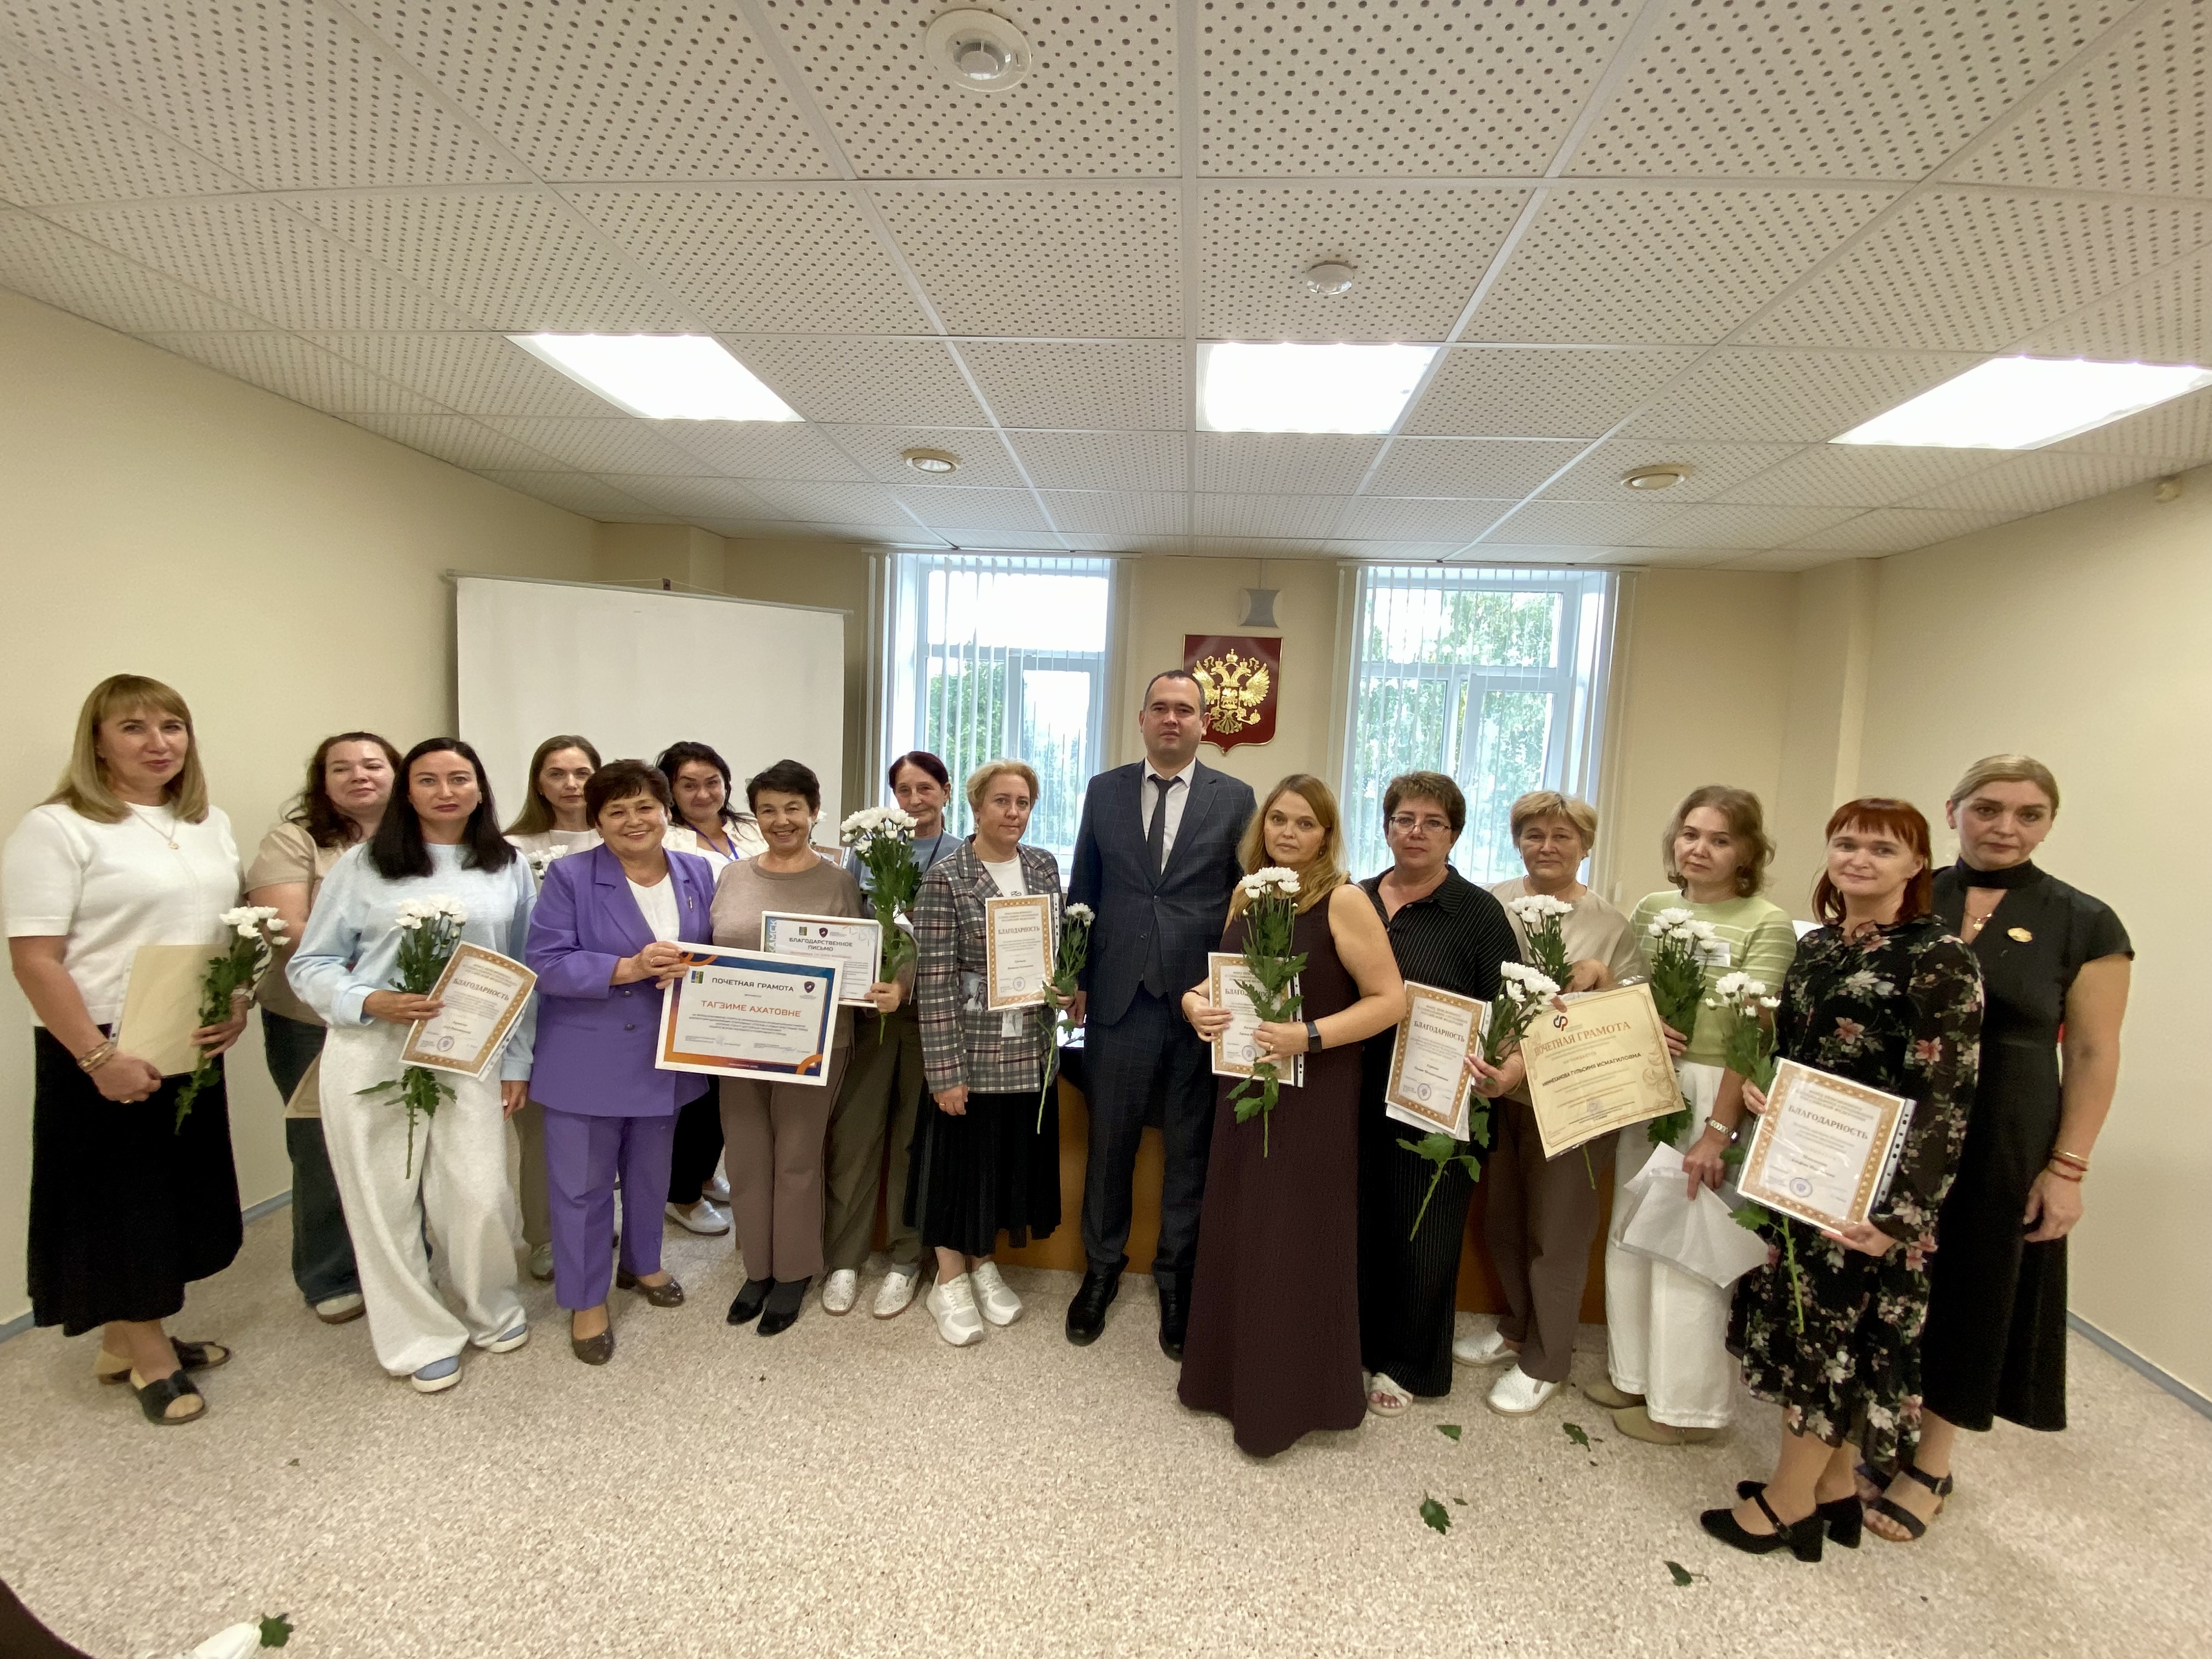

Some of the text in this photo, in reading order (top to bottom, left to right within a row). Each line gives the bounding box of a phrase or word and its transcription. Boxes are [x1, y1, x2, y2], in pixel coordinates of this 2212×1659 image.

[998, 926, 1040, 935] БЛАГОДАРНОСТЬ
[789, 937, 853, 947] БЛАГОДАРСТВЕННОЕ
[453, 978, 510, 1001] БЛАГОДАРНОСТЬ
[712, 977, 794, 992] ПОЧЕТНАЯ ГРАМОТА
[701, 1000, 802, 1017] ТАГЗИМЕ АХАТОВНЕ
[1414, 1020, 1465, 1042] БЛАГОДАРНОСТЬ
[1534, 1034, 1575, 1057] ПОЧЕТНАЯ
[1577, 1021, 1632, 1041] ГРАМОТА
[1597, 1052, 1641, 1068] ИСМАГИЛОВНА
[1788, 1105, 1868, 1140] БЛАГОДАРНОСТЬ
